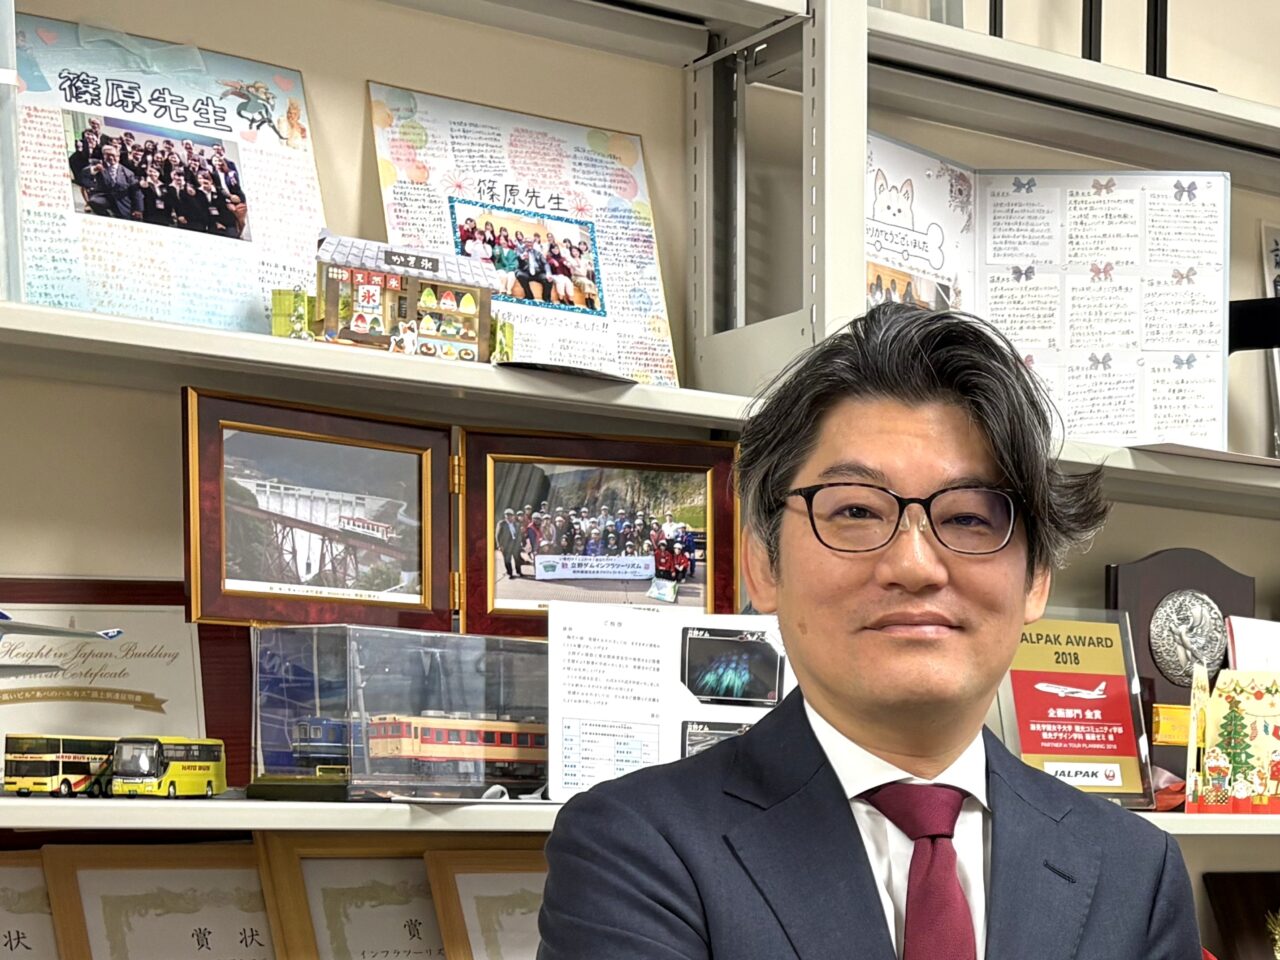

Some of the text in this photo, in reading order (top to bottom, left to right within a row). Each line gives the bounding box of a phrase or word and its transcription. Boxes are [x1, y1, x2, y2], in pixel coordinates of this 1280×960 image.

[59, 69, 233, 133] 篠原先生
[477, 178, 569, 212] 篠原先生
[391, 254, 433, 270] かき氷
[361, 289, 377, 305] 氷
[1065, 635, 1114, 649] AWARD
[117, 641, 180, 665] Building
[1054, 651, 1080, 666] 2018
[1055, 770, 1099, 779] JALPAK
[403, 918, 423, 941] 賞
[2, 930, 33, 952] 状
